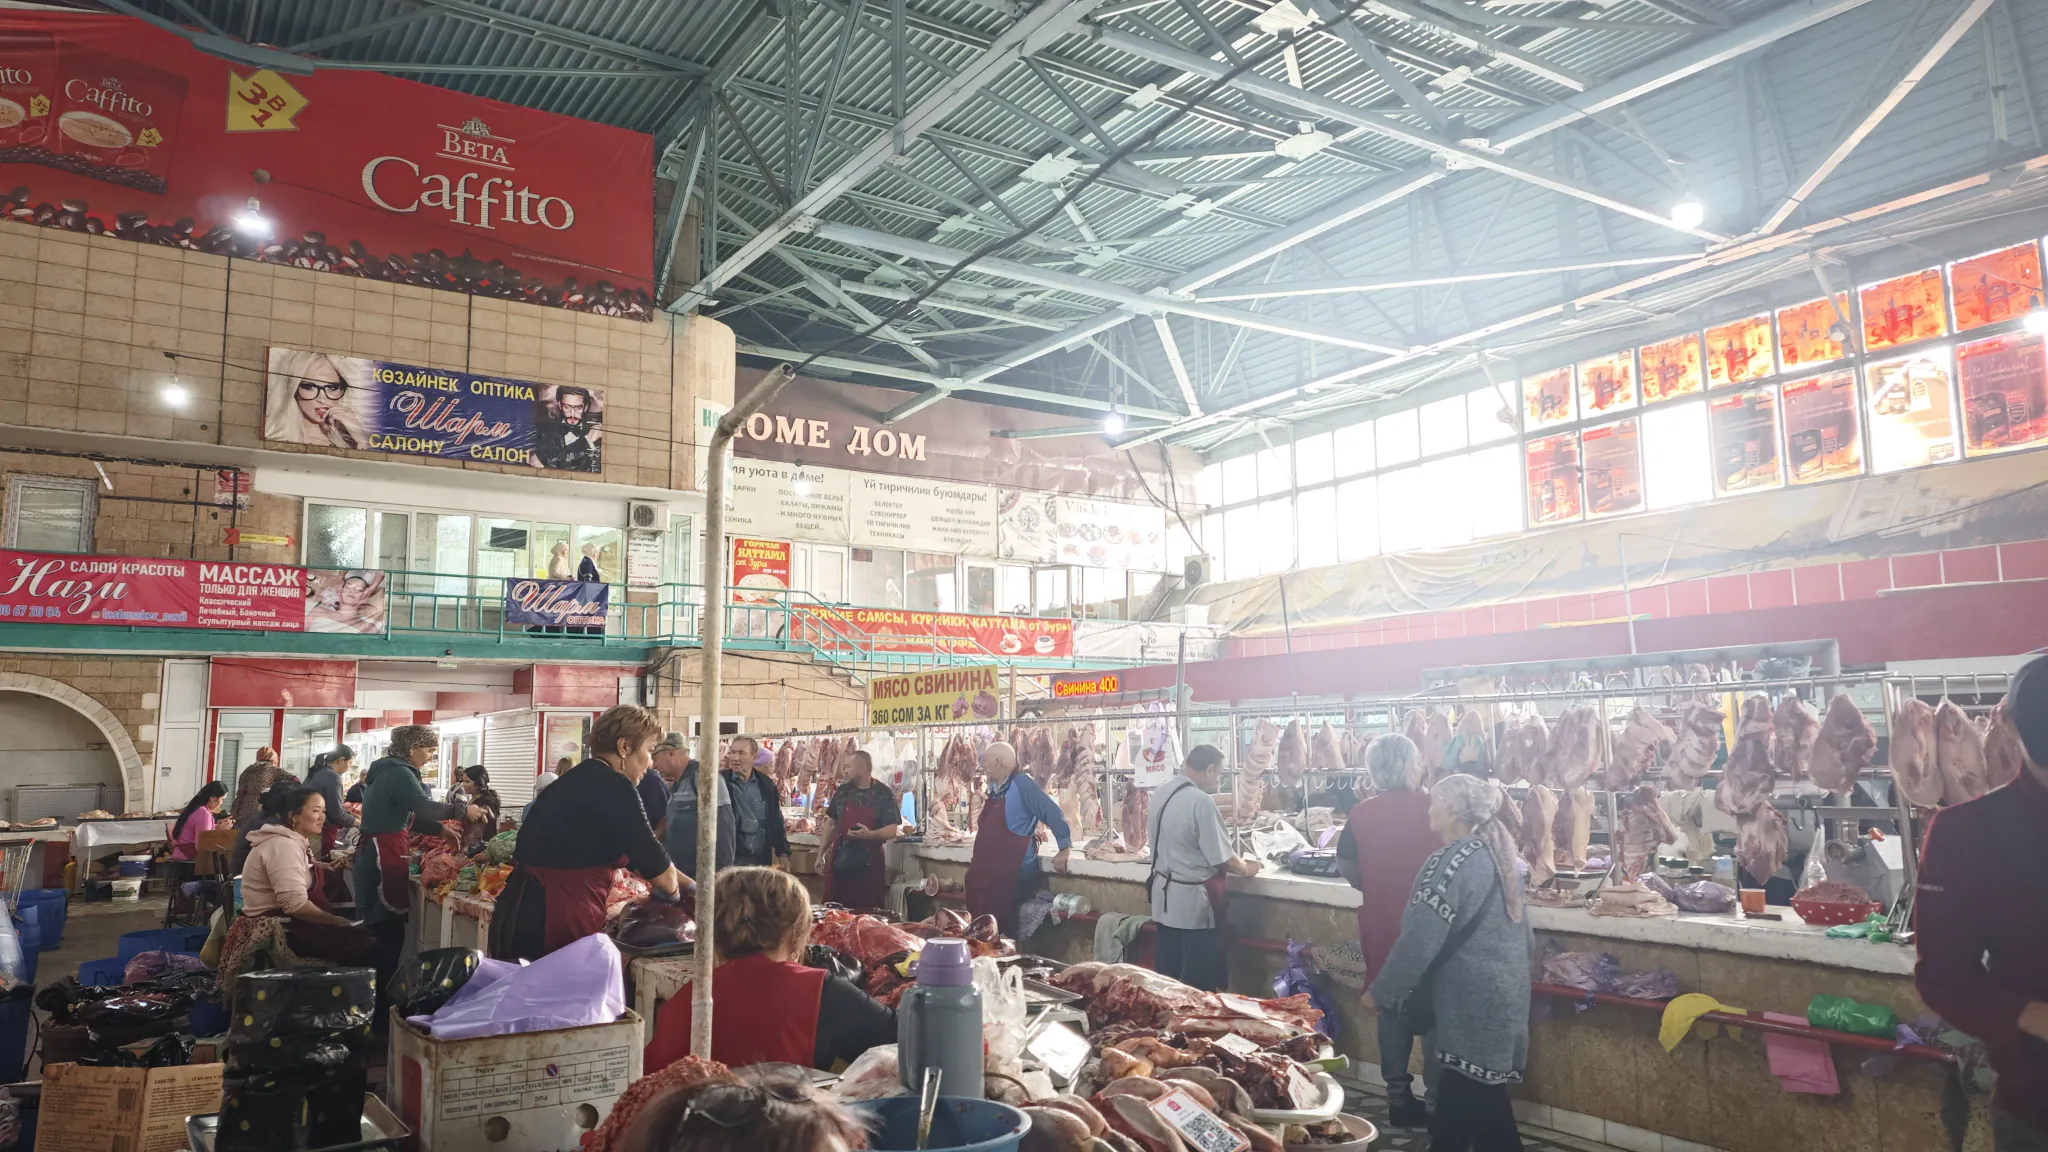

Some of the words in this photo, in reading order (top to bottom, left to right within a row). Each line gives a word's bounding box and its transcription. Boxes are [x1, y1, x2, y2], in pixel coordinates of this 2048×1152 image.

[64, 79, 153, 117] Caffito
[443, 130, 510, 165] BETA
[361, 155, 575, 230] Caffito
[372, 368, 459, 393] КӨЗАЙНЕК
[470, 380, 535, 401] ОПТИКА
[390, 390, 513, 445] Шарм
[734, 412, 831, 449] OME
[846, 424, 926, 462] ДОМ
[368, 433, 445, 454] САЛОНУ
[470, 444, 530, 464] САЛОН
[733, 465, 745, 475] ля
[749, 467, 778, 478] уюта
[732, 484, 756, 492] ДАРКИ
[879, 482, 931, 496] тиричилик
[933, 486, 987, 503] буюмдары!
[780, 500, 810, 510] ХАЛАТЫ,
[811, 503, 843, 512] ПИЖАМЫ
[724, 515, 752, 524] ЕХНИКА
[787, 510, 812, 519] МНОГО
[813, 513, 843, 522] НУЖНЫХ
[870, 510, 907, 519] СУВЕНИРЛЕР
[869, 530, 905, 539] ТЕХНИКАСЫ
[743, 540, 780, 549] ГОРЯЧАЯ
[737, 547, 786, 561] КАТТАМА
[70, 561, 117, 573] САЛОН
[121, 563, 185, 577] КРАСОТЫ
[200, 564, 300, 587] МАССАЖ
[200, 583, 236, 595] ТОЛЬКО
[237, 585, 258, 597] ДЛЯ
[260, 585, 300, 598] ЖЕНЩИН
[199, 596, 251, 607] Классический
[511, 580, 600, 624] Шарм
[199, 607, 238, 617] Лечебный,
[239, 608, 276, 618] Баночный
[566, 615, 605, 625] ОПТИКА
[198, 617, 251, 628] Скульптурный
[252, 619, 281, 628] массаж
[281, 620, 300, 629] лица
[857, 610, 908, 626] САМСЫ,
[911, 612, 970, 629] КУРНИКИ,
[973, 617, 1027, 630] КАТТАМА
[1029, 621, 1040, 631] от
[1045, 621, 1072, 632] Зуры
[873, 679, 910, 700] МЯСО
[914, 668, 995, 696] СВИНИНА
[1055, 680, 1097, 697] Свинина
[1099, 676, 1117, 693] 400
[872, 708, 889, 724] 360
[891, 706, 914, 723] СОМ
[917, 706, 932, 721] ЗА
[935, 704, 950, 721] КГ
[1145, 764, 1166, 773] МЯСО
